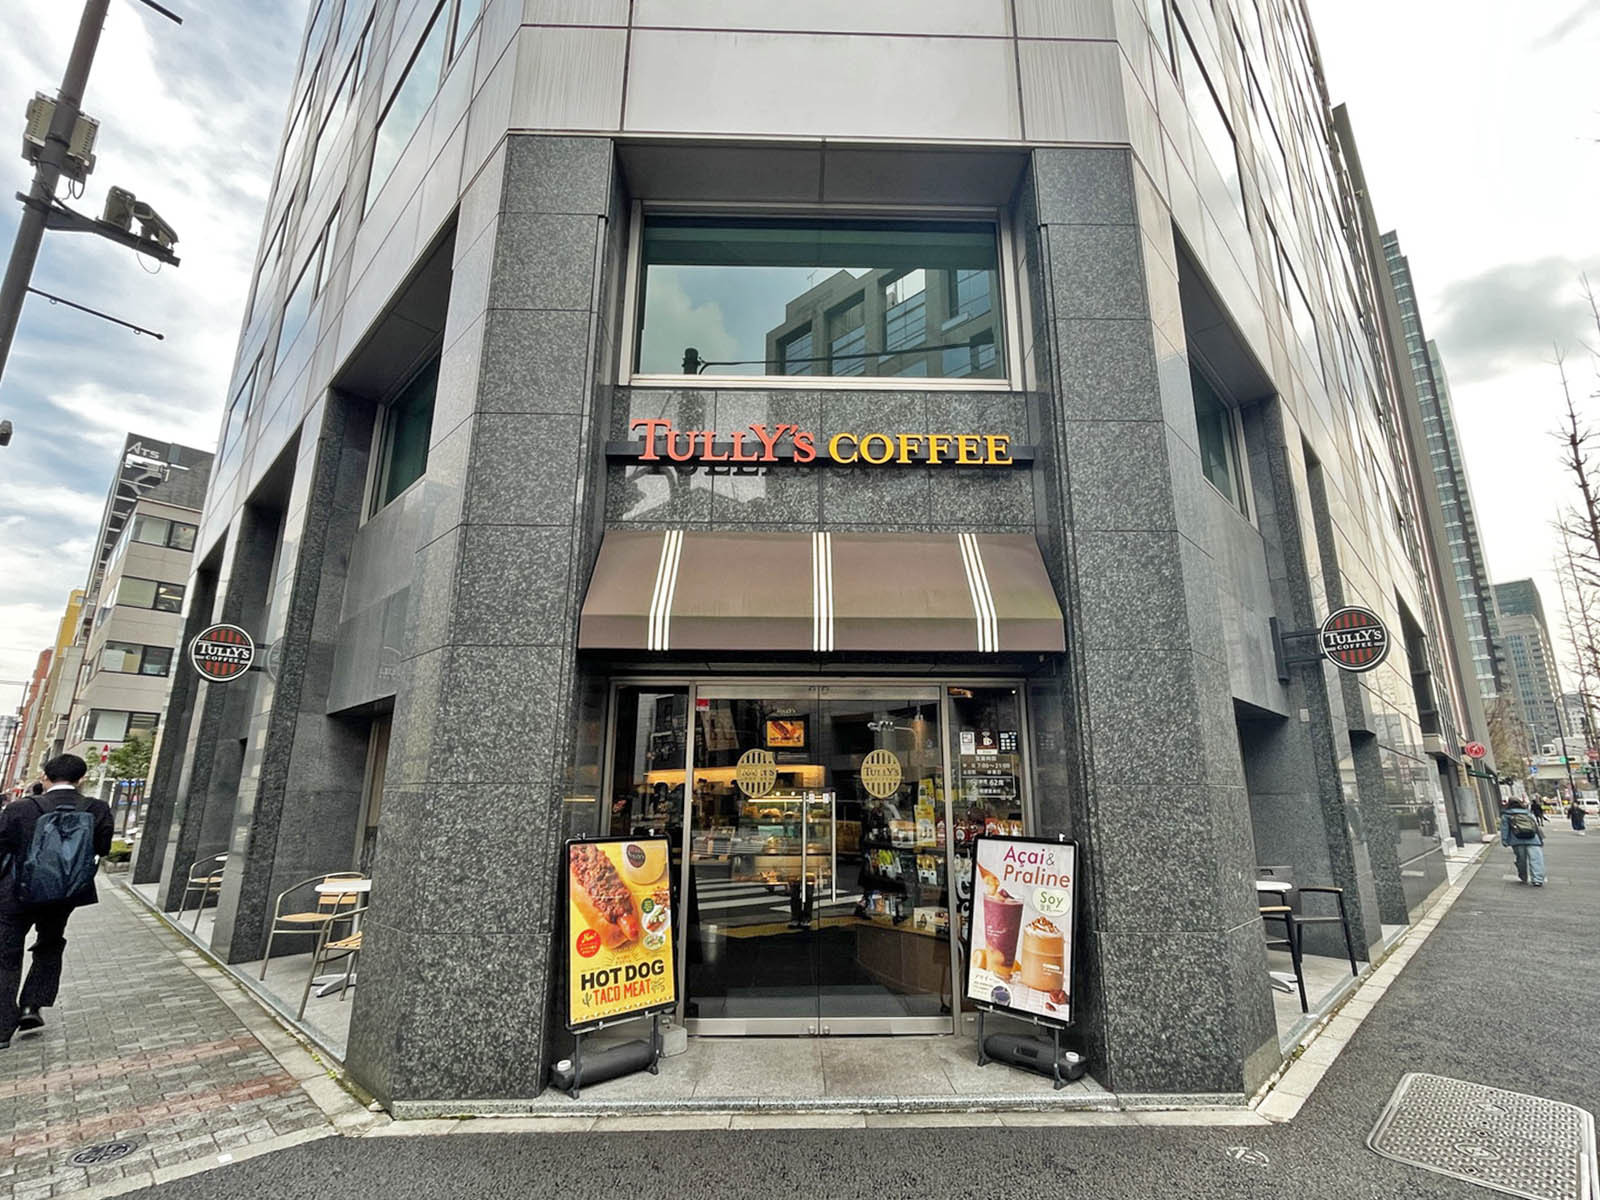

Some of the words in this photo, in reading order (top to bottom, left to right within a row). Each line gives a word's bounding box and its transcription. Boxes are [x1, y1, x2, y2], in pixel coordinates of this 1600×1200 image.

[127, 441, 160, 459] ATS
[631, 418, 816, 463] TULLY'S
[828, 433, 1013, 465] COFFEE
[1325, 629, 1382, 645] TULLY'S
[1337, 641, 1373, 650] COFFEE
[198, 642, 250, 659] TULLY'S
[1003, 864, 1071, 888] Praline
[1040, 891, 1064, 908] Soy
[581, 967, 622, 991] HOT
[625, 959, 665, 982] DOG
[593, 985, 620, 1006] TACO
[624, 979, 651, 1000] MEAT
